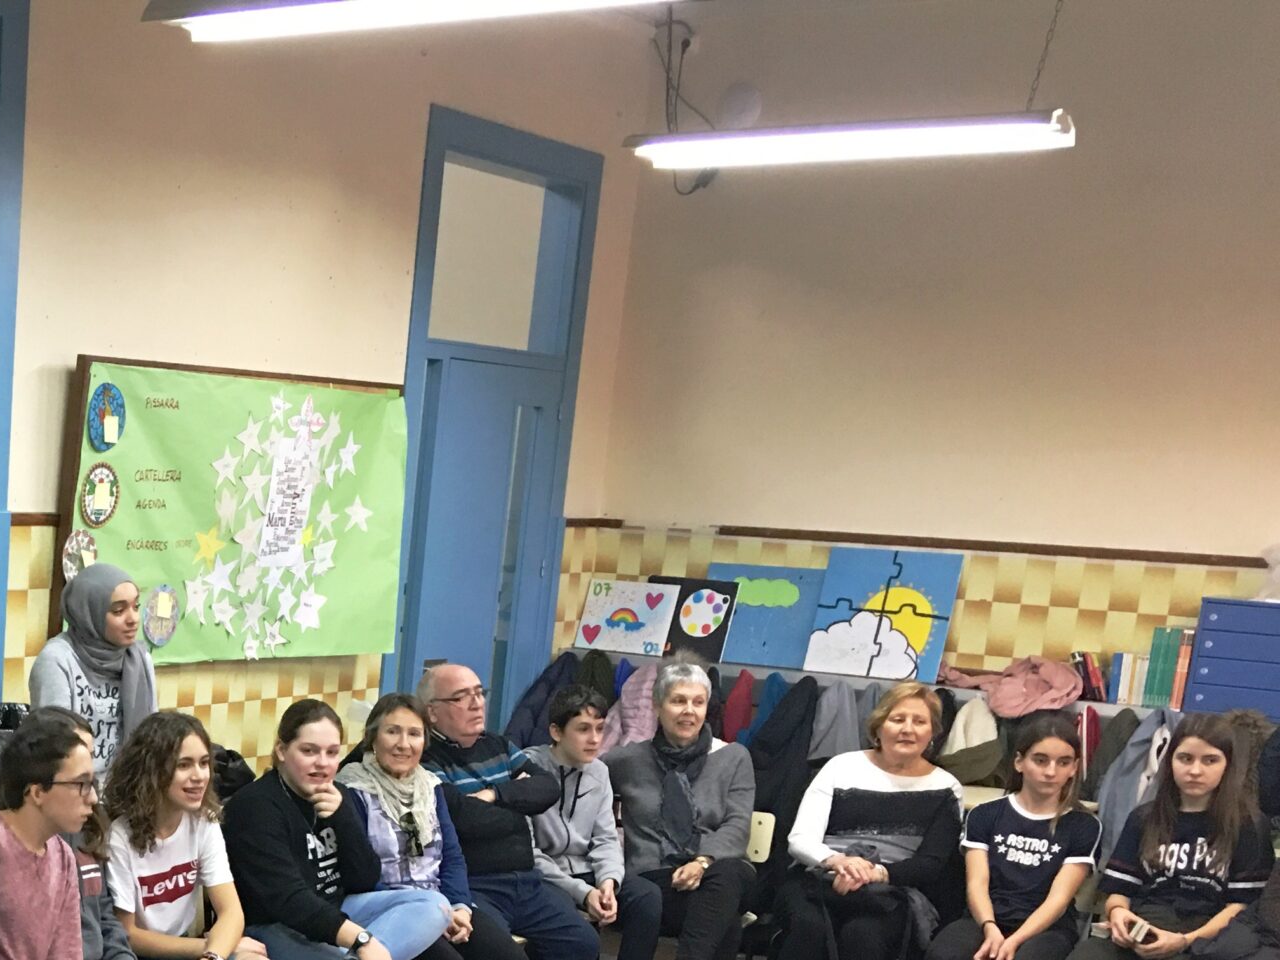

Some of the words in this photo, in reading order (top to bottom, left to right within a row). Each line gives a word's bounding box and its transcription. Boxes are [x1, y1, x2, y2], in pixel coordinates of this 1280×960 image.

[145, 396, 180, 410] PISSARRA
[134, 469, 182, 482] CARTELLERA
[135, 499, 166, 510] AGENDA
[75, 674, 120, 700] Smile
[80, 698, 94, 716] is
[1006, 834, 1049, 852] ASTRO
[1006, 848, 1041, 866] BABE
